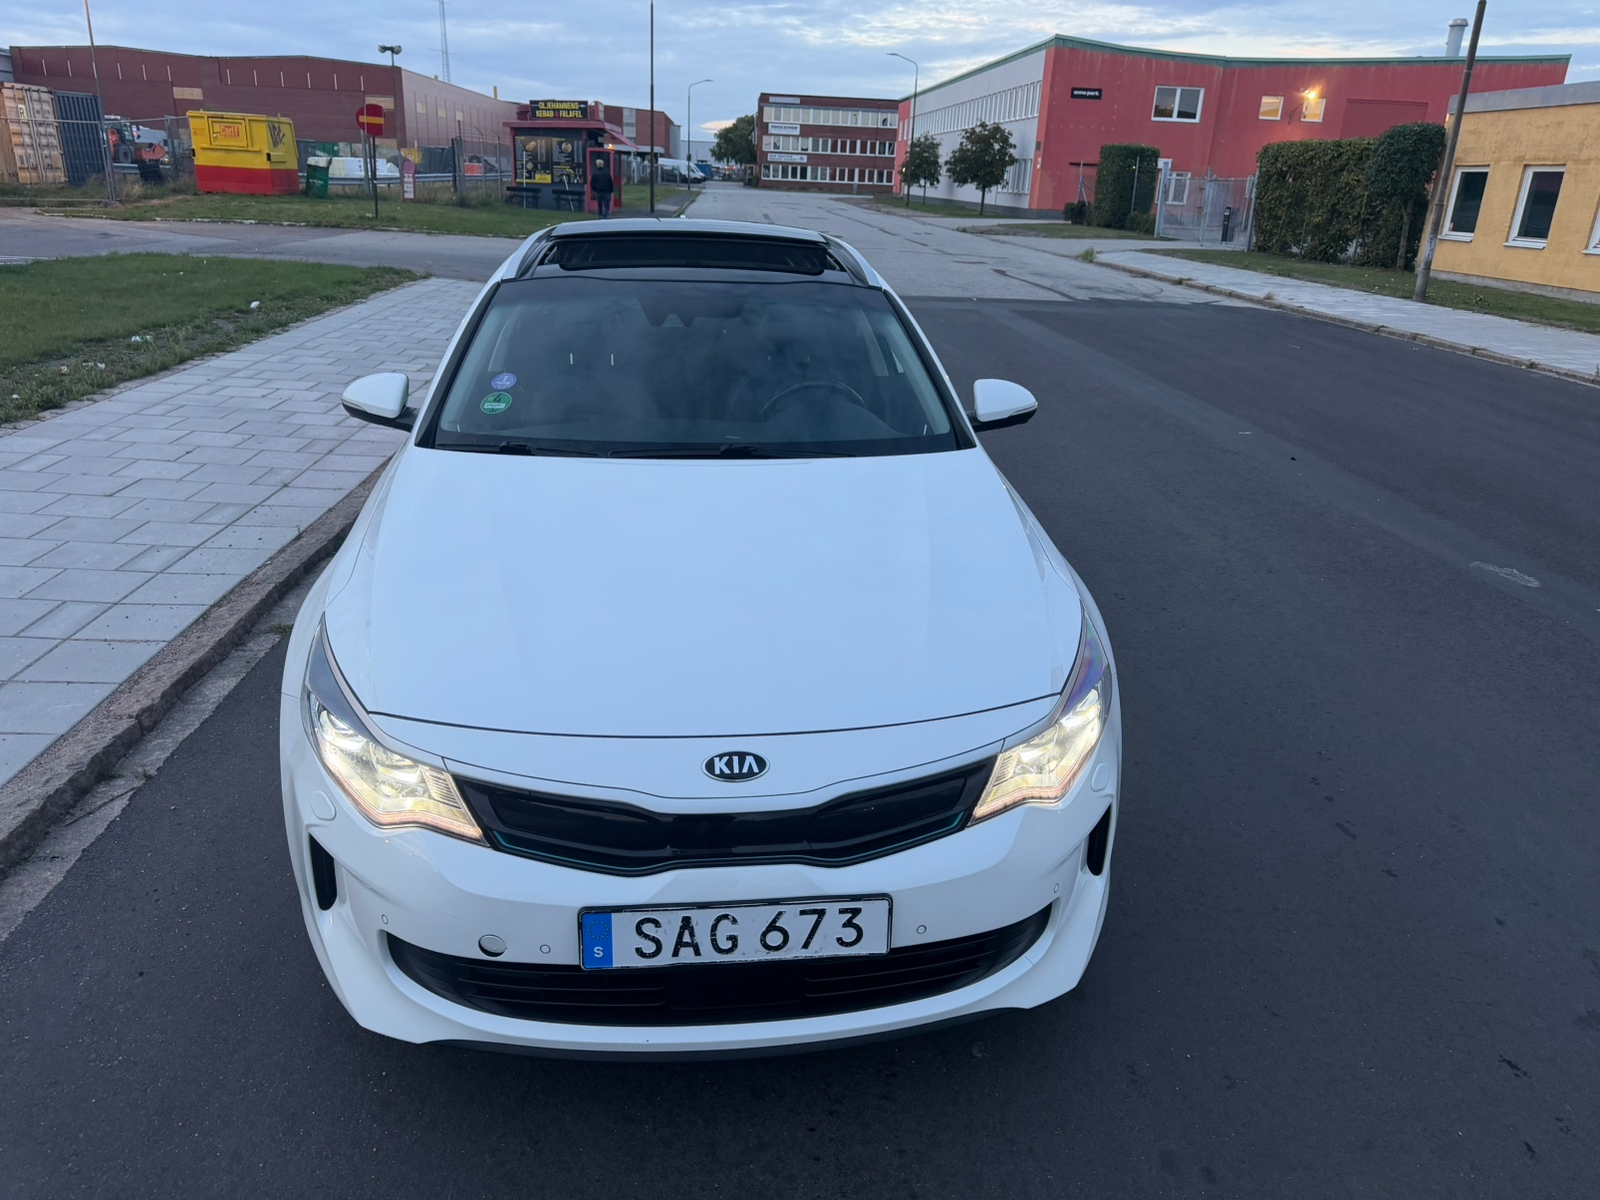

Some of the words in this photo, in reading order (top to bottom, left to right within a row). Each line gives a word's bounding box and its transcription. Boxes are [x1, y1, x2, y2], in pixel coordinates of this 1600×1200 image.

[713, 755, 760, 775] KIA
[634, 913, 739, 960] SAG
[759, 907, 865, 953] 673
[593, 946, 604, 958] S
